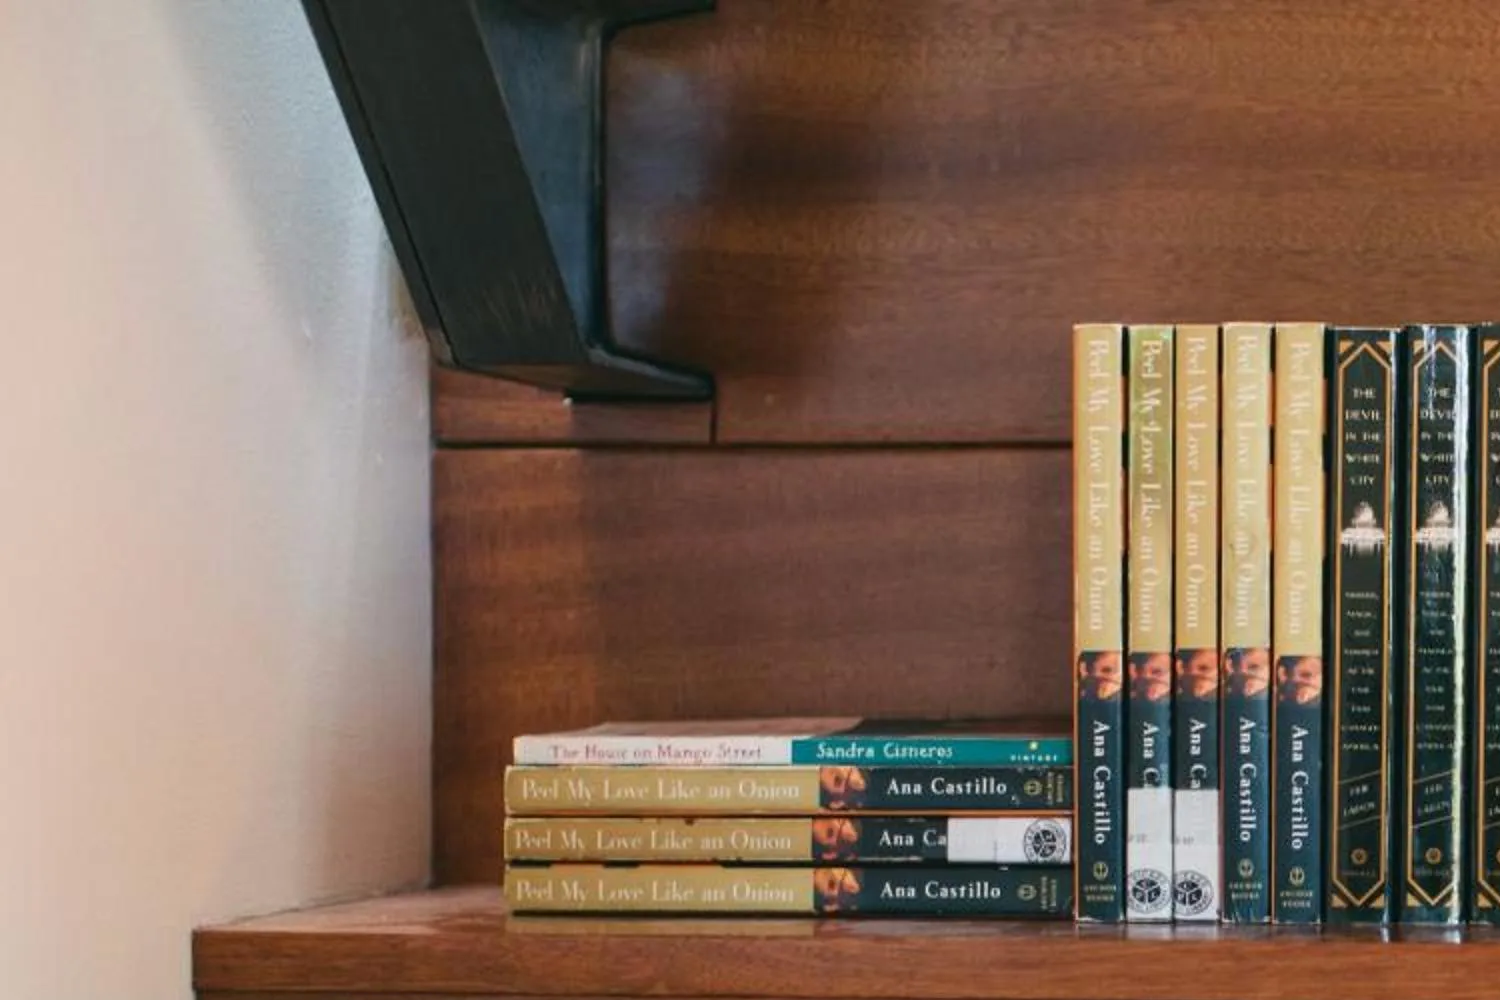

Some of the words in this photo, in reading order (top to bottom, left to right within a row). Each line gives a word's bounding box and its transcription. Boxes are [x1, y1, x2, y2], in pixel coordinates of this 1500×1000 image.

[1345, 409, 1381, 420] DEVIL
[815, 742, 875, 759] Sandra
[883, 742, 953, 759] Cisneros
[1093, 719, 1111, 758] Ana
[1143, 721, 1161, 760] Ana
[1189, 718, 1208, 756] Ana
[1238, 717, 1257, 755] Ana
[1291, 724, 1309, 763] Ana
[551, 745, 579, 759] The
[585, 744, 628, 760] House
[633, 749, 652, 760] on
[657, 745, 711, 763] Mango
[716, 743, 762, 759] Street
[522, 777, 559, 800] Peel
[567, 779, 595, 807] My
[603, 779, 649, 800] Love
[657, 779, 702, 800] Like
[708, 784, 731, 800] an
[738, 779, 801, 801] Onion
[886, 778, 923, 796] Ana
[930, 776, 1008, 796] Castillo
[1093, 765, 1112, 845] Castillo
[1238, 762, 1258, 843] Castillo
[1291, 770, 1310, 850] Castillo
[515, 830, 551, 851] Peel
[560, 830, 586, 856] My
[596, 830, 643, 851] Love
[651, 830, 694, 851] Like
[701, 835, 724, 851] an
[730, 830, 792, 851] Onion
[878, 829, 915, 847] Ana
[515, 880, 554, 902] Peel
[561, 880, 588, 908] My
[599, 880, 645, 902] Love
[652, 880, 697, 902] Like
[702, 885, 728, 902] an
[732, 881, 795, 903] Onion
[880, 882, 916, 900] Ana
[923, 880, 1002, 900] Castillo
